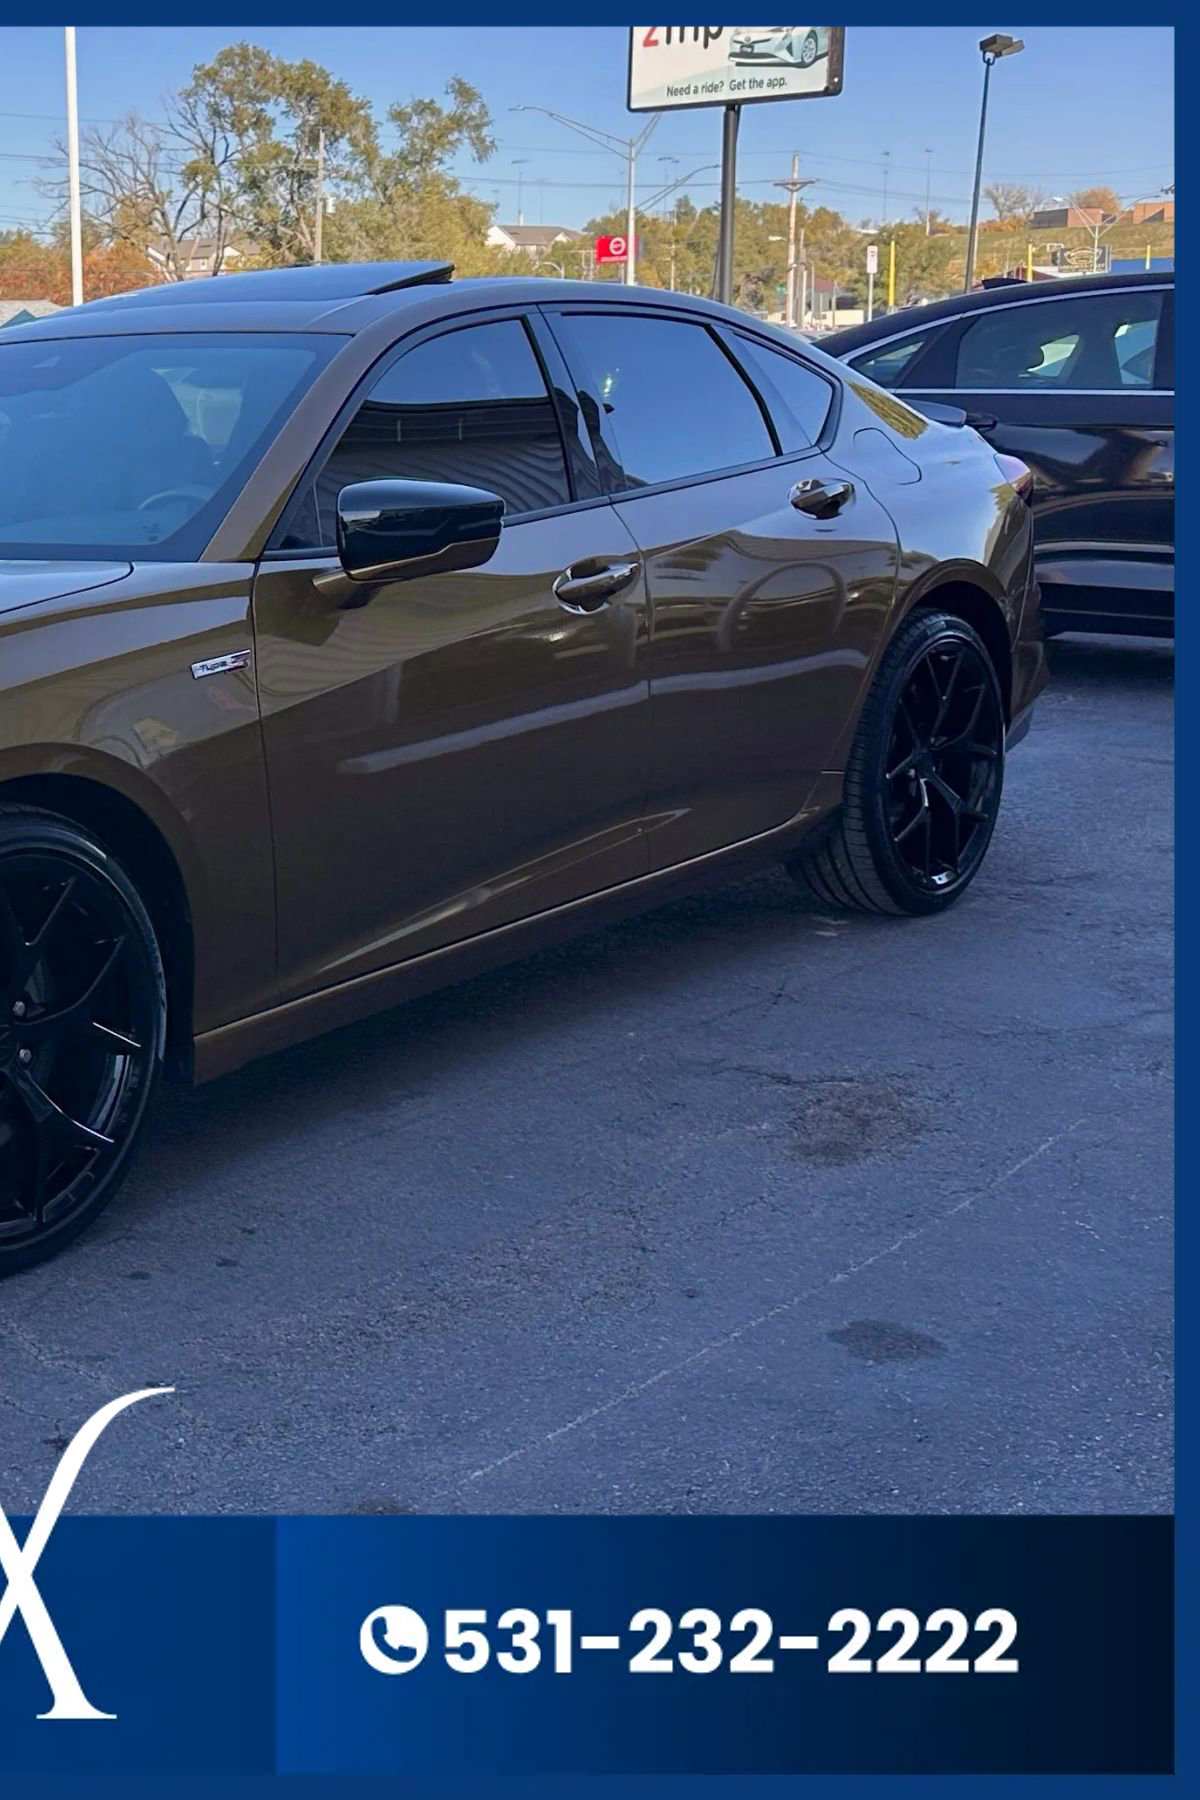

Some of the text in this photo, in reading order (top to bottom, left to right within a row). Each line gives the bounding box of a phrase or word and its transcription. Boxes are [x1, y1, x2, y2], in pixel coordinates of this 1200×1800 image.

[666, 77, 788, 97] Need a ride? Get the app.
